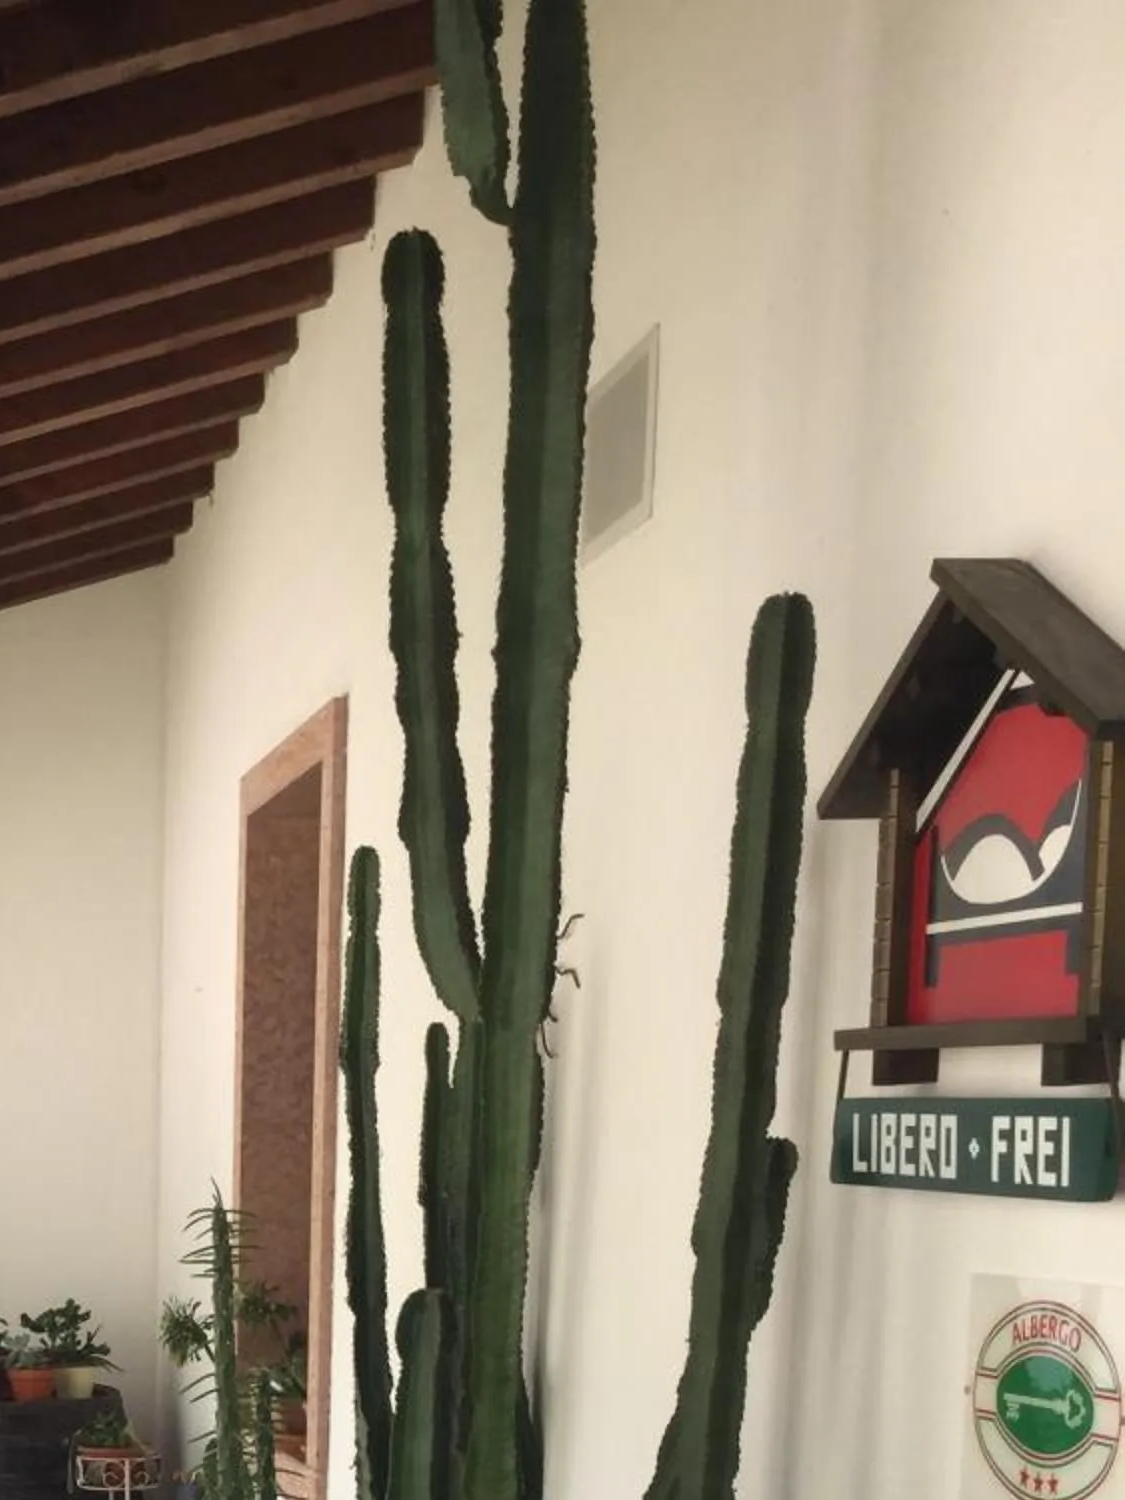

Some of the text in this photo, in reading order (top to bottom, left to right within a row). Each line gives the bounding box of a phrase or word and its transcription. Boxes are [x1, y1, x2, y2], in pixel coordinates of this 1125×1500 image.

[852, 1112, 1071, 1188] LIBERO FREI
[1011, 1314, 1082, 1353] ALBERGO
